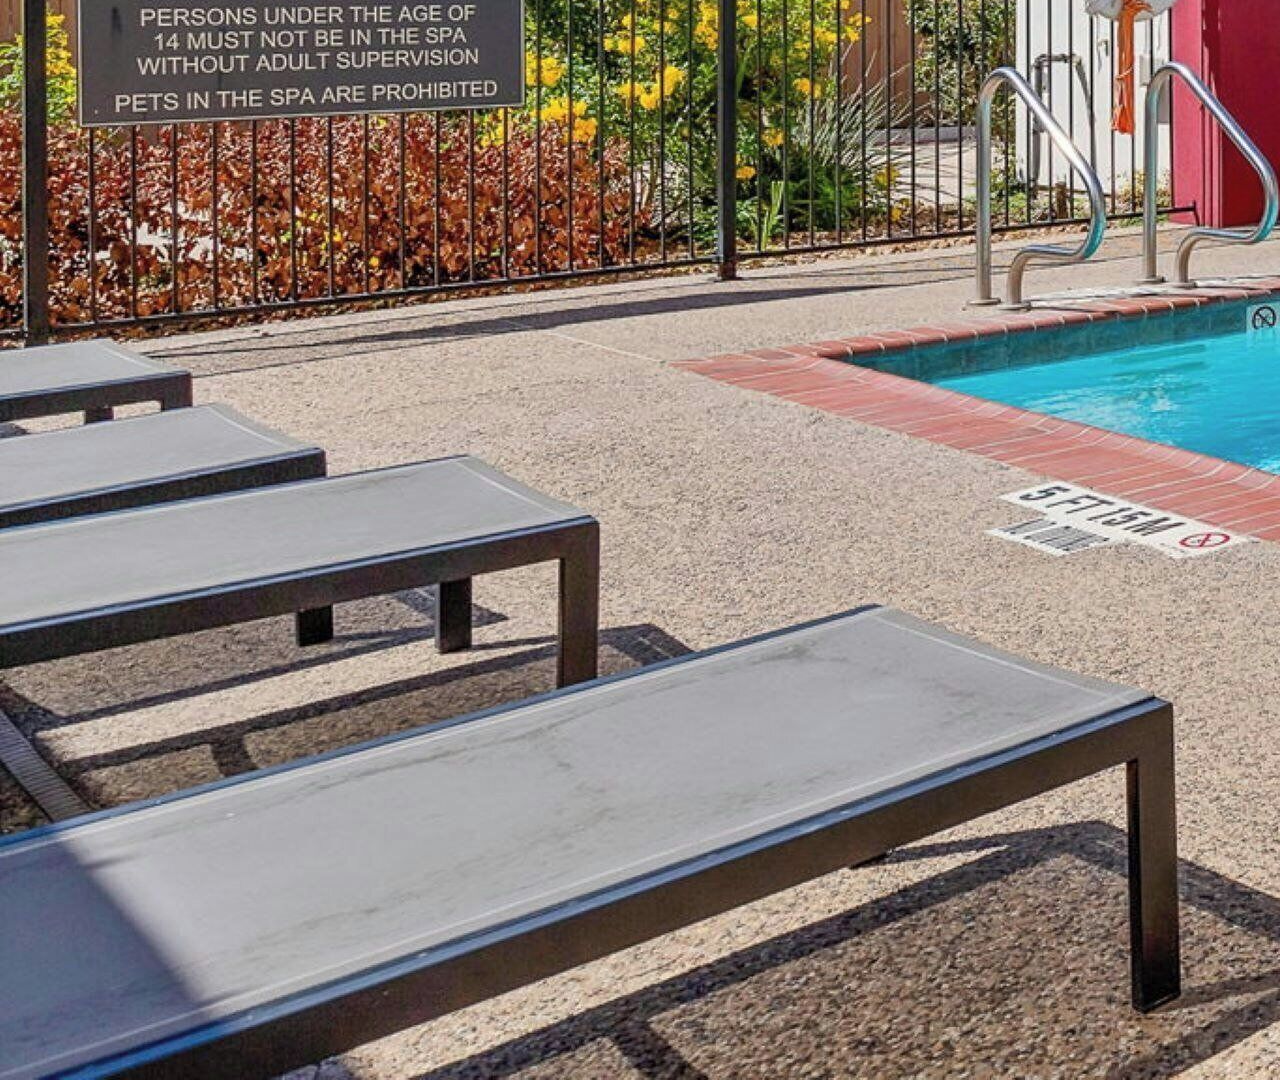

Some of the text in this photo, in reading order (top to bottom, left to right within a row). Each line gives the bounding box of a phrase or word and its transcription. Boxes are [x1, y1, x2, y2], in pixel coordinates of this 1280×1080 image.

[140, 4, 477, 27] PERSONS UNDER THE AGE OF
[154, 26, 468, 51] 14 MUST NOT BE IN THE SPA
[137, 48, 480, 76] WITHOUT ADULT SUPERVISION
[115, 79, 499, 113] PETS IN THE SPA ARE PROHIBITED
[1019, 486, 1070, 501] 5
[1046, 494, 1115, 514] FT
